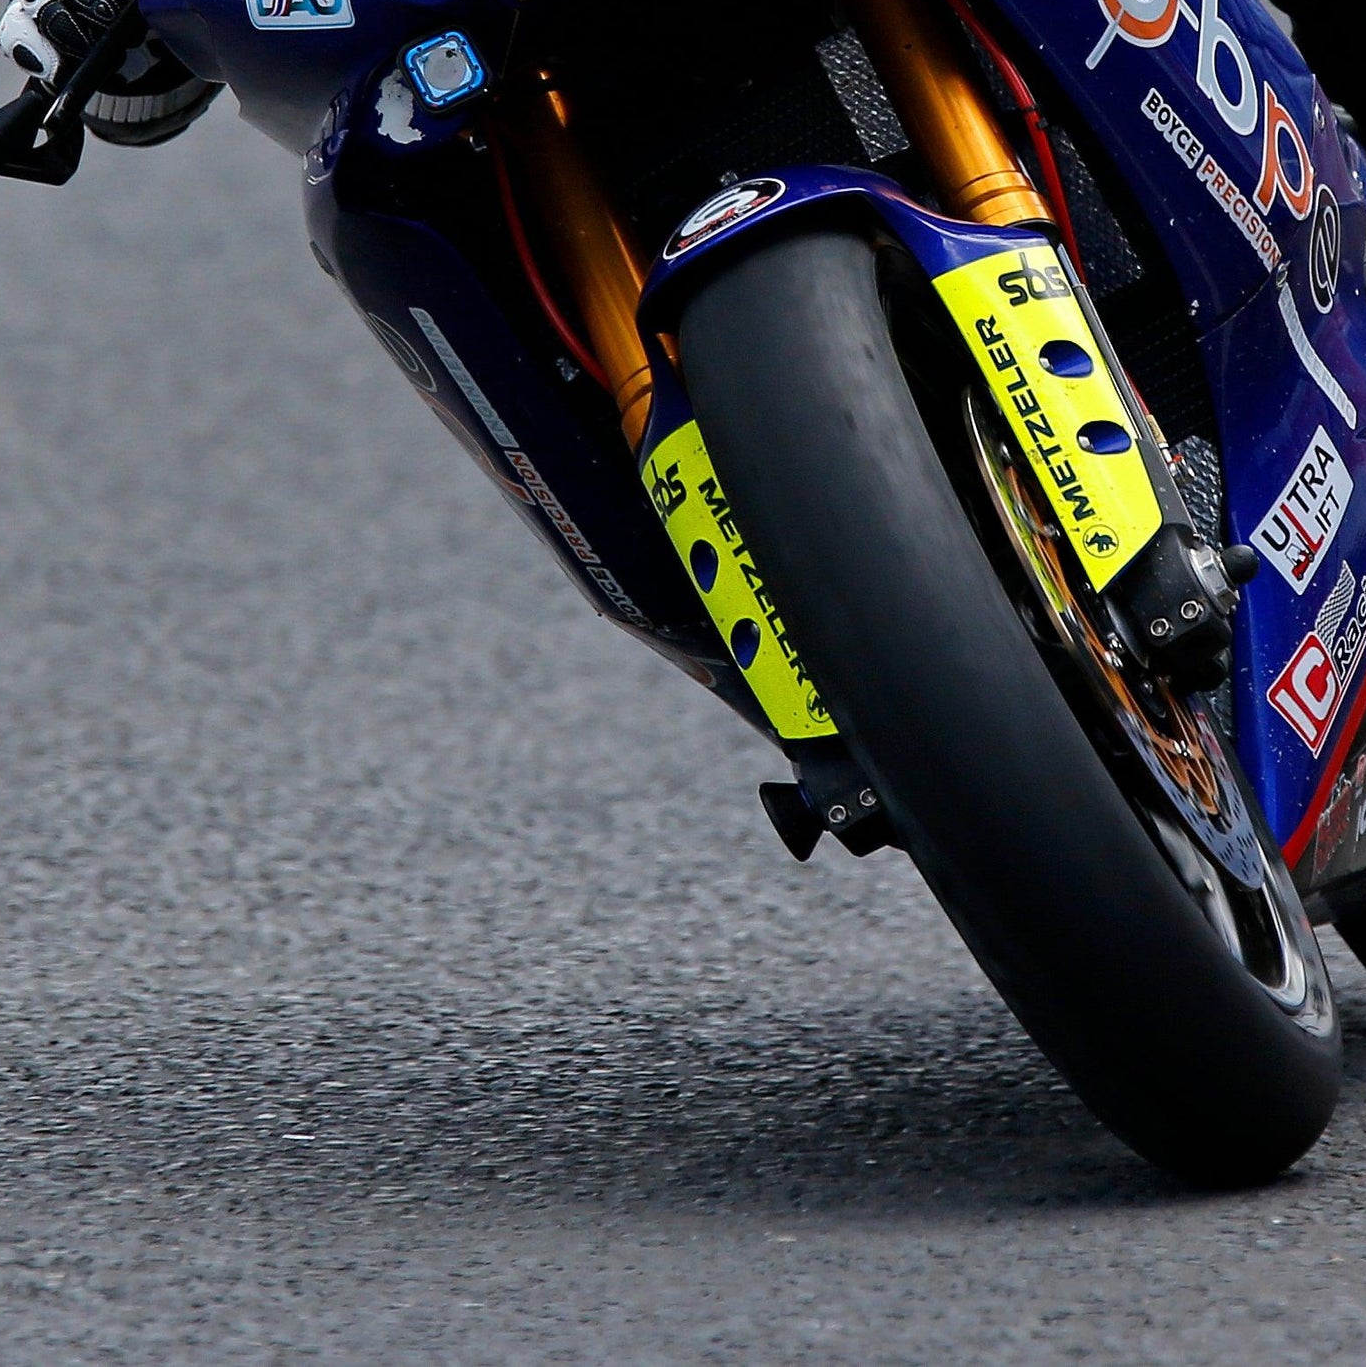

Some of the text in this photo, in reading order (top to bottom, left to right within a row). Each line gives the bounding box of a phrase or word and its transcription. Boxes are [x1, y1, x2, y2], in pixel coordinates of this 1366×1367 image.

[1143, 90, 1203, 165] BOYCE
[1201, 157, 1282, 268] PRECISION
[974, 314, 1096, 522] METZELER
[508, 453, 598, 562] PRECISION
[698, 476, 813, 692] METZELER
[1274, 640, 1337, 740] IC
